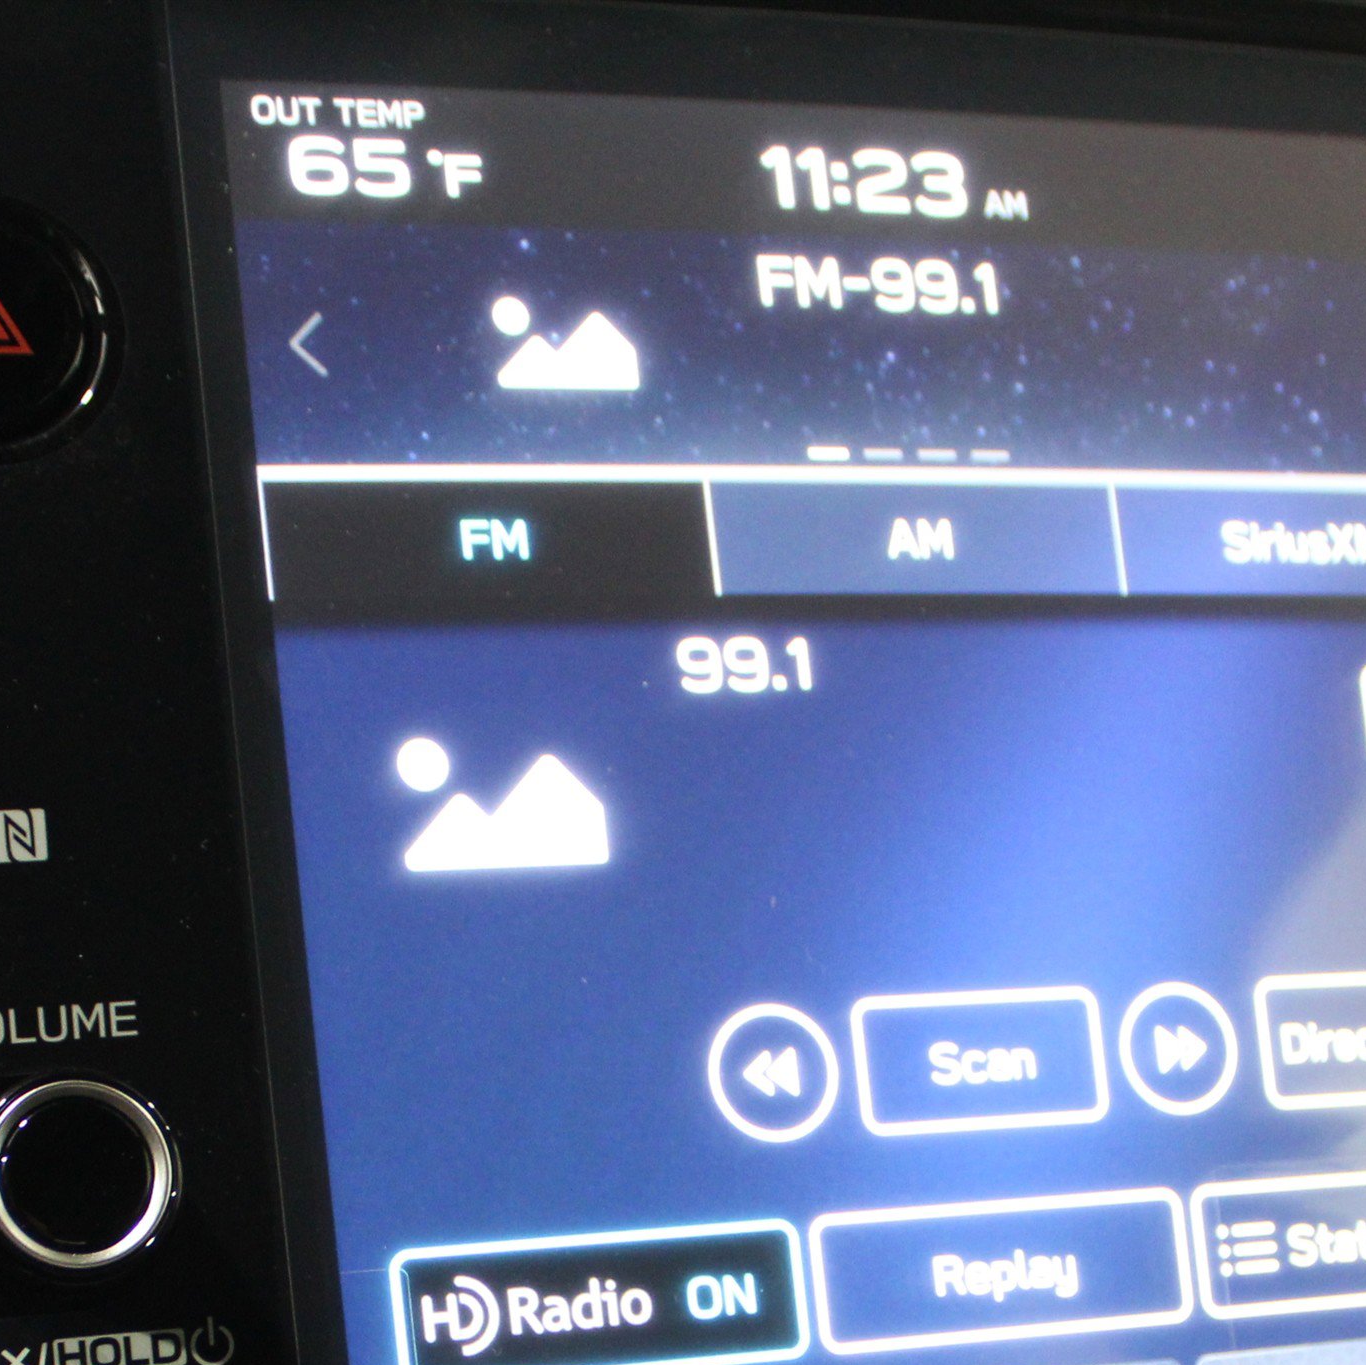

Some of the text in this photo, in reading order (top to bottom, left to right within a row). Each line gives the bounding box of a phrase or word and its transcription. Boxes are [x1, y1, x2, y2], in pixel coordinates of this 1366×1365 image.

[250, 95, 425, 131] OUT TEMP
[286, 136, 411, 198] 65
[760, 146, 1029, 220] 11:23 AM
[756, 254, 1000, 315] FM-99.1
[458, 518, 531, 562] FM
[886, 520, 955, 560] AM
[677, 636, 813, 694] 99.1
[928, 1040, 1036, 1086] Scan
[932, 1250, 1077, 1301] Replay
[508, 1281, 652, 1335] Radio
[685, 1274, 757, 1321] ON
